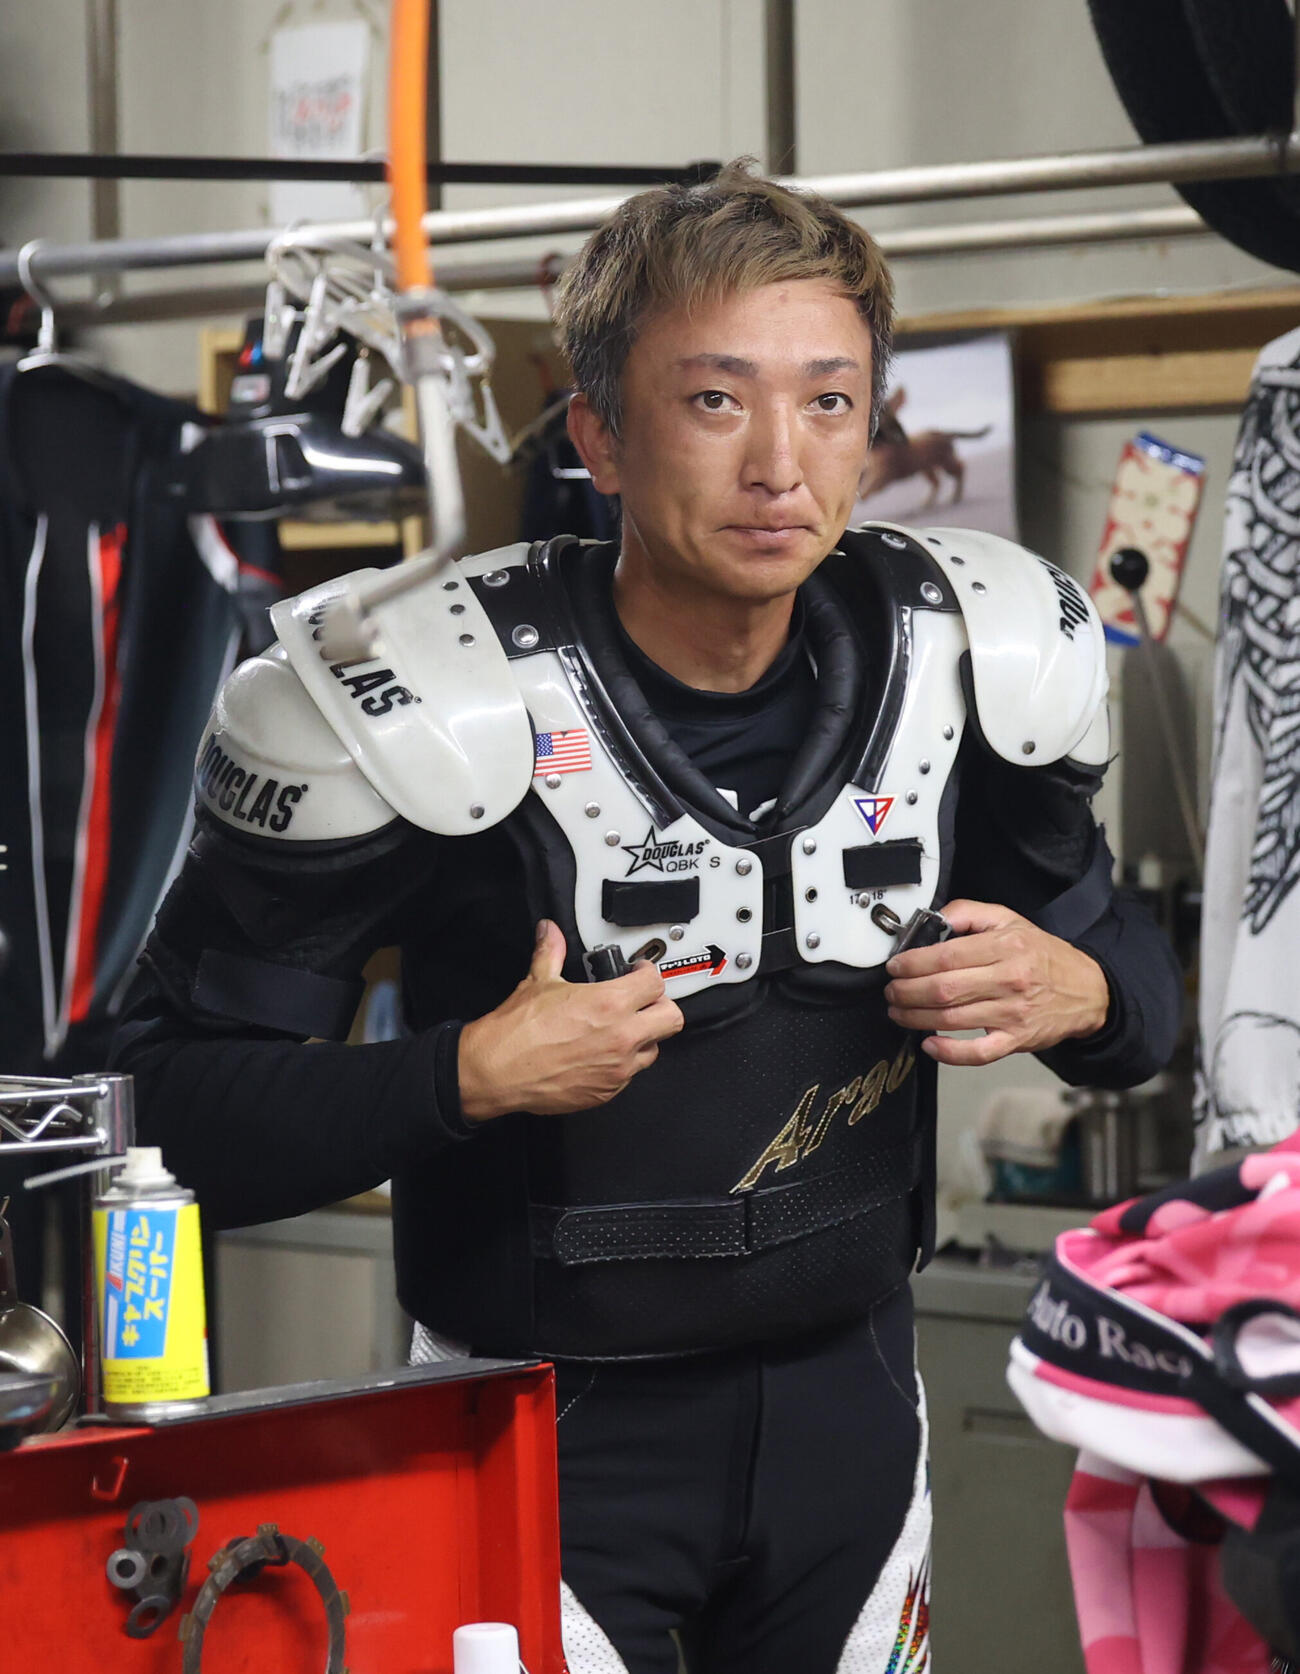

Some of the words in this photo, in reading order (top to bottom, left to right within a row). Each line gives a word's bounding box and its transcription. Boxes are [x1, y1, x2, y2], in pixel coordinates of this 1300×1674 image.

[642, 841, 706, 861] DOUGLAS
[666, 857, 699, 873] QBK
[709, 856, 721, 868] S
[143, 1230, 169, 1322] スーパー
